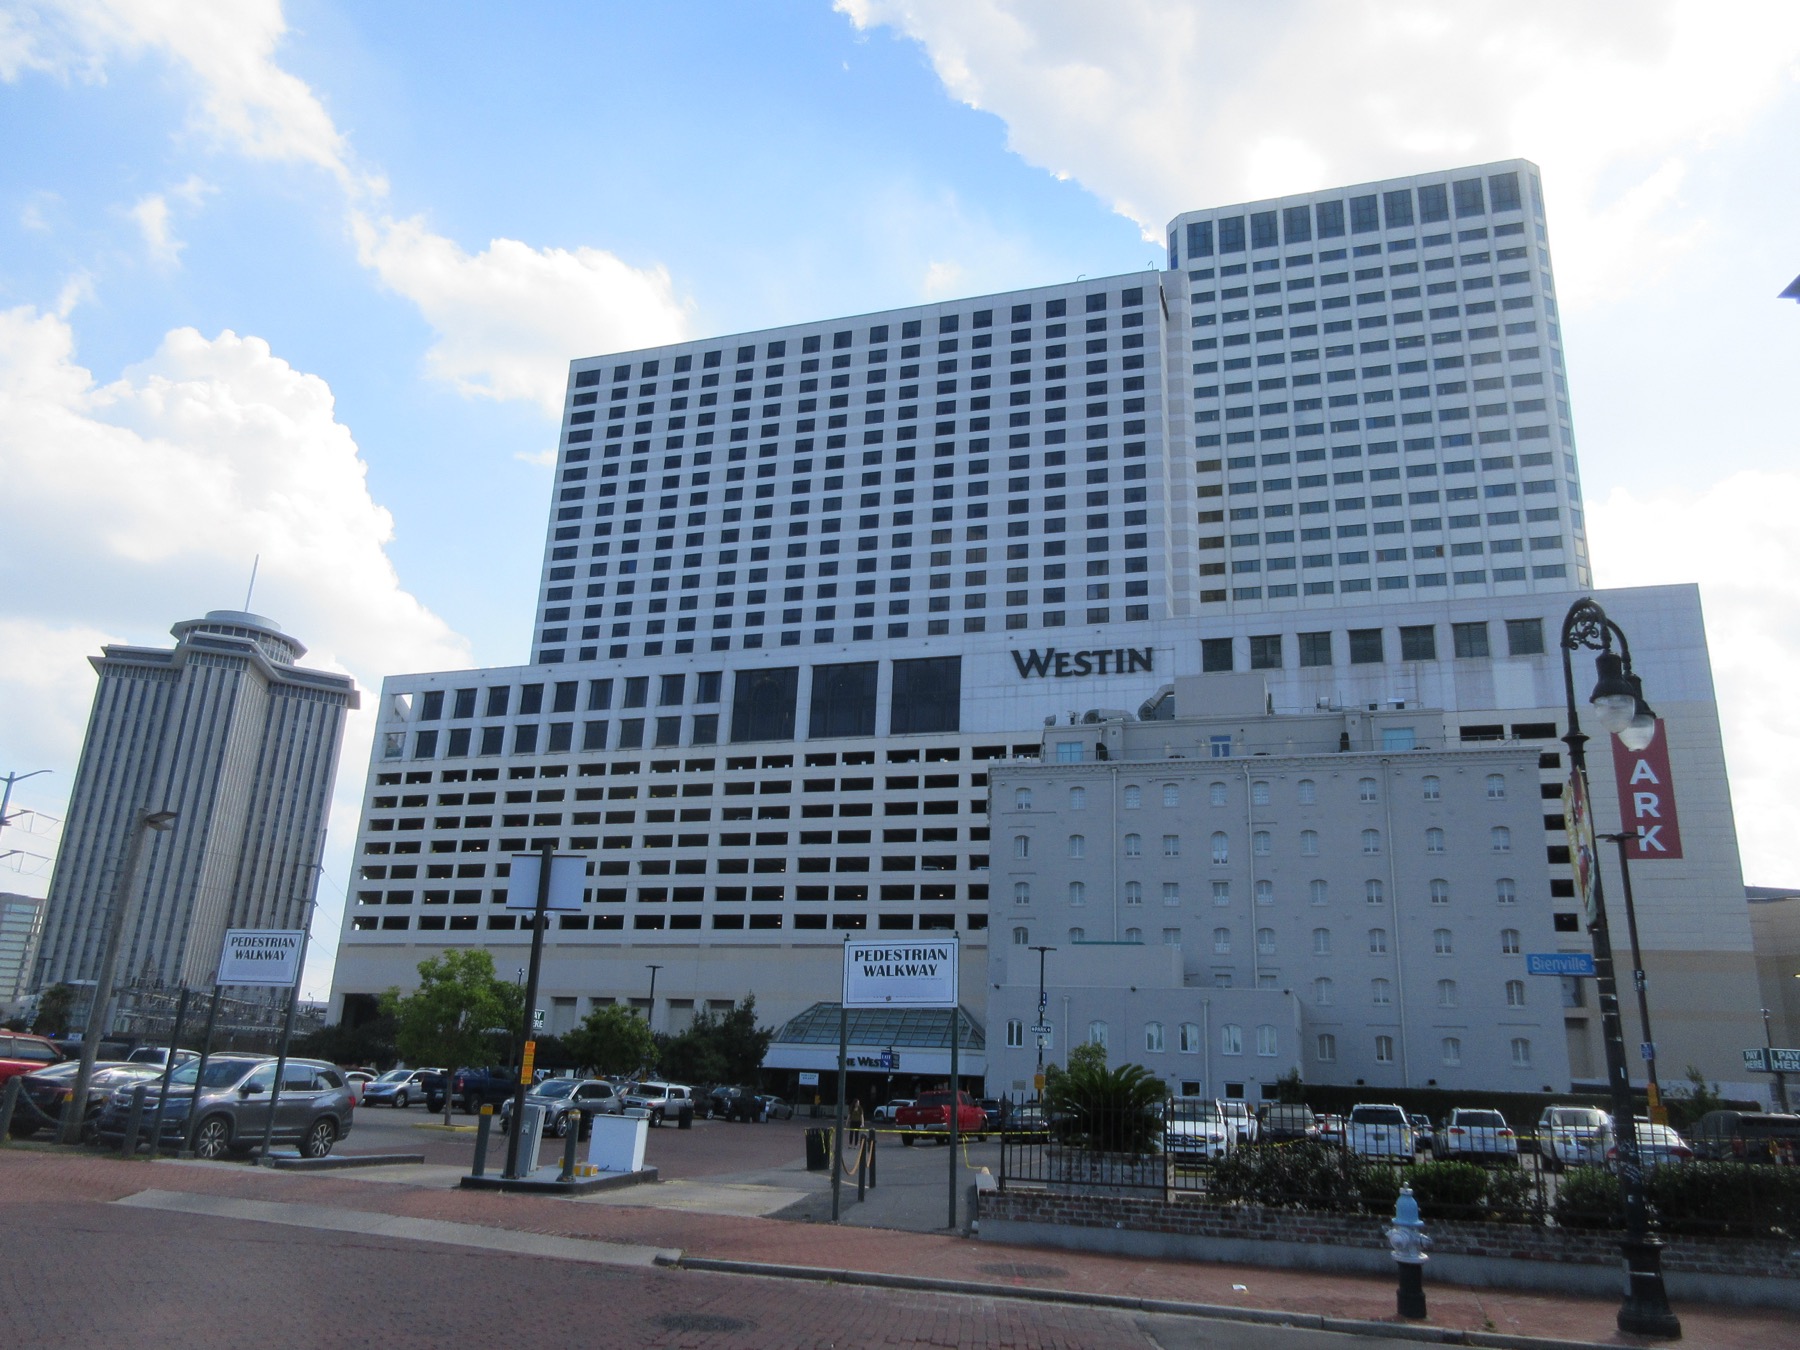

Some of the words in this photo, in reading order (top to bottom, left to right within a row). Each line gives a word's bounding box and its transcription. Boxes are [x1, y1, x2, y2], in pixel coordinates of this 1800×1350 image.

[1011, 647, 1153, 679] WESTIN
[1629, 759, 1667, 852] ARK
[231, 936, 296, 948] PEDESTRIAN
[235, 949, 287, 961] WALKWAY
[854, 948, 948, 962] PEDESTRIAN
[1531, 956, 1587, 971] Bienville
[863, 964, 938, 977] WALKWAY
[1745, 1051, 1758, 1060] PAY
[1776, 1051, 1800, 1060] PAY
[1744, 1060, 1763, 1069] HERE
[1773, 1060, 1800, 1070] HER
